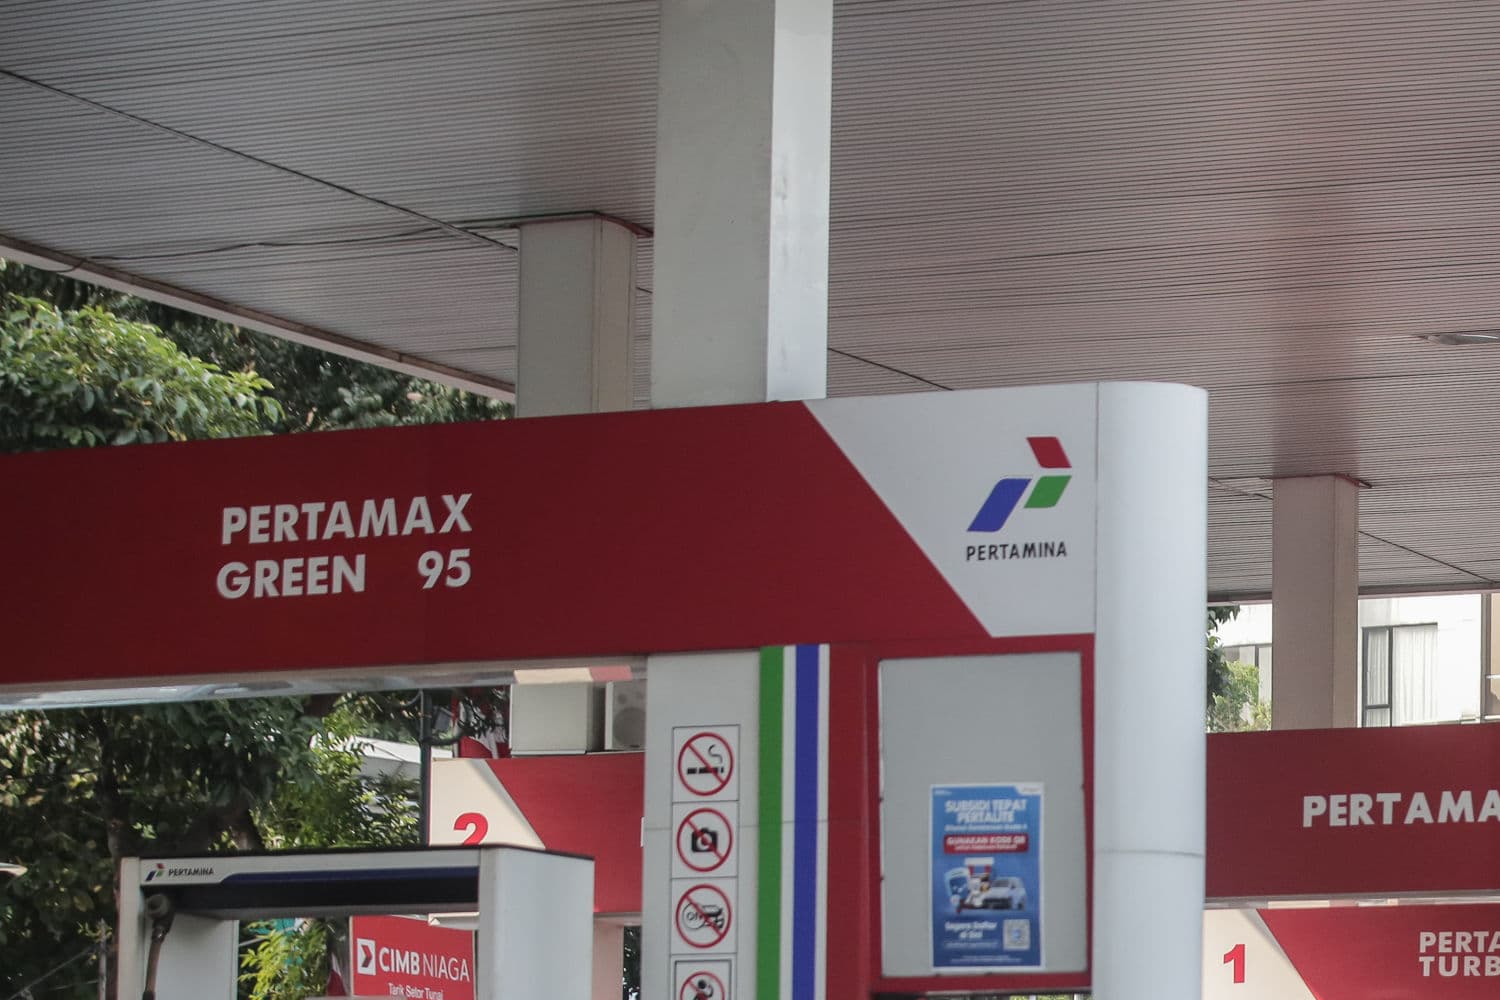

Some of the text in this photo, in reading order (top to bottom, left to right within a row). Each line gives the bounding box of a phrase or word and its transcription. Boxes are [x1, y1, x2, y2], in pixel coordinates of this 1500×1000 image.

[221, 493, 472, 544] PERTAMAX
[966, 541, 1067, 561] PERTAMINA
[216, 549, 471, 599] GREEN 95
[454, 812, 489, 846] 2
[168, 867, 215, 877] PERTAMINA
[379, 947, 470, 982] CIMB NIAGA
[1223, 944, 1245, 983] 1
